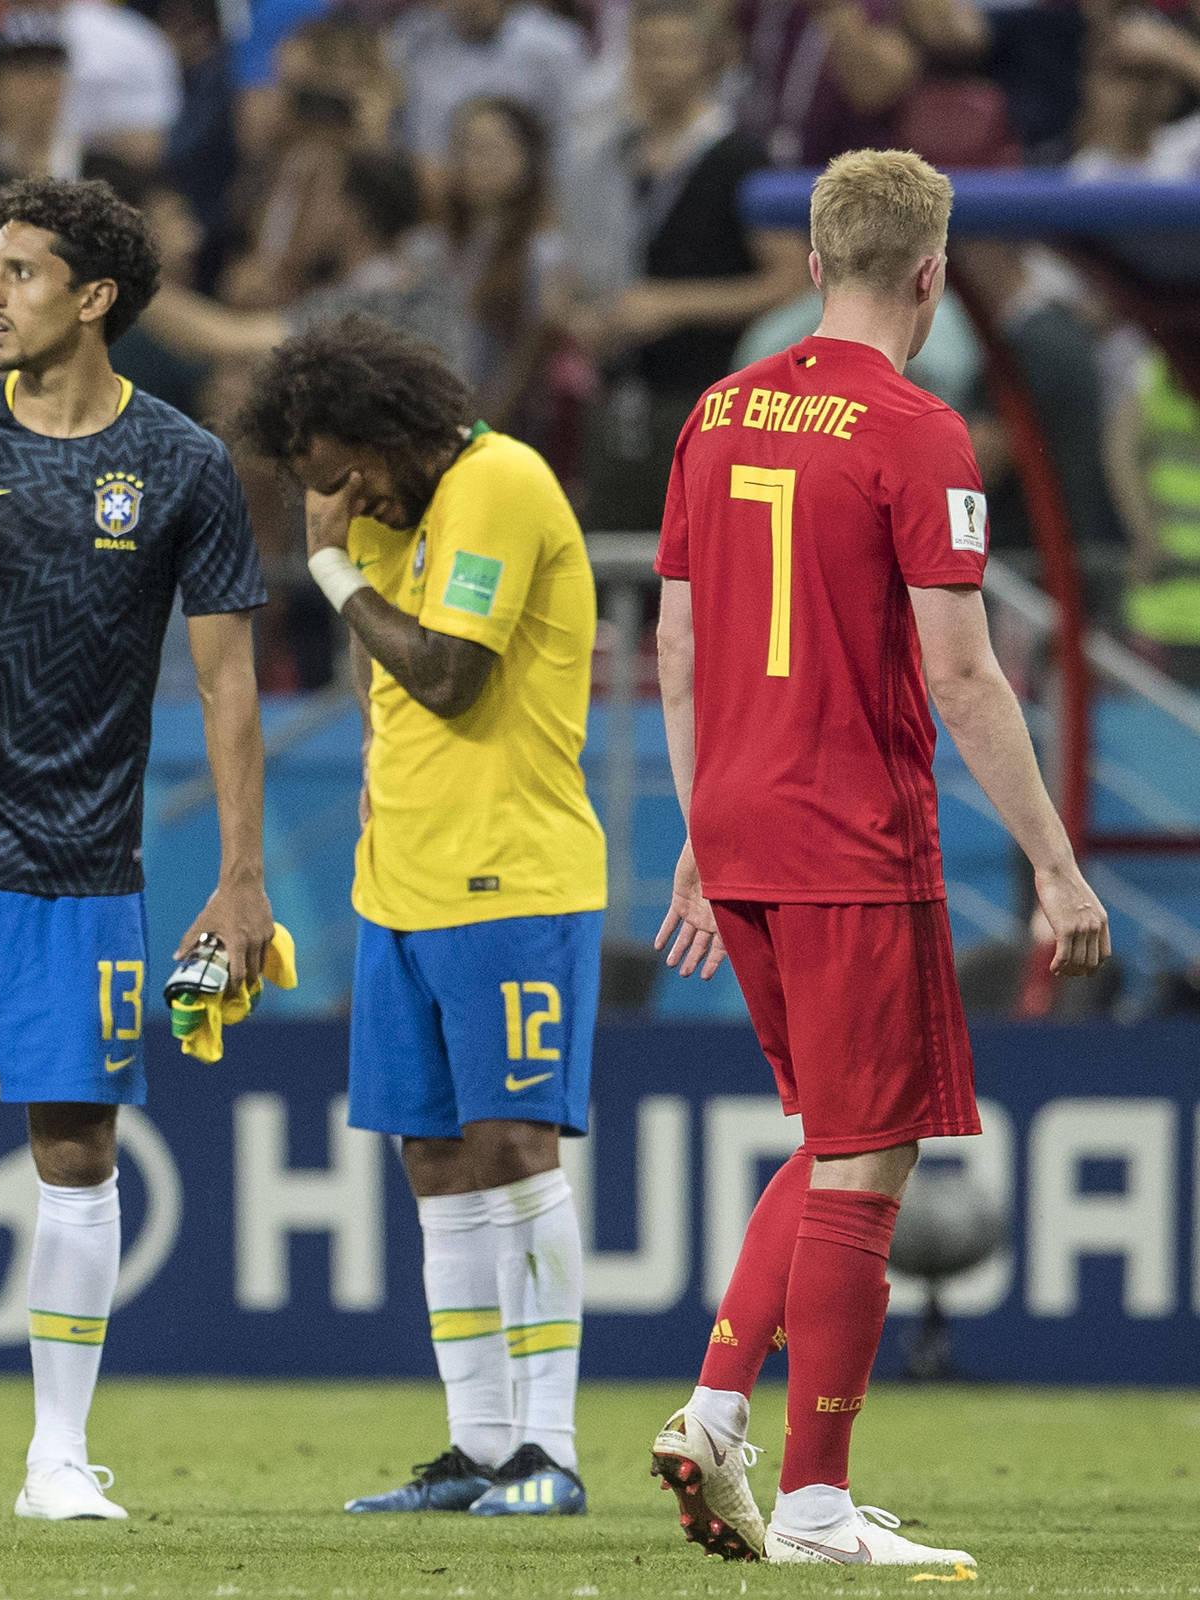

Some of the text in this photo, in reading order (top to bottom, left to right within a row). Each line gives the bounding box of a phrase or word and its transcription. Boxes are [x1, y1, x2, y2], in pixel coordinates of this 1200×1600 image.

[701, 387, 868, 440] DE BRUYNE
[95, 538, 137, 551] BRASIL
[730, 464, 797, 677] 7
[97, 960, 144, 1040] 13
[500, 981, 561, 1060] 12
